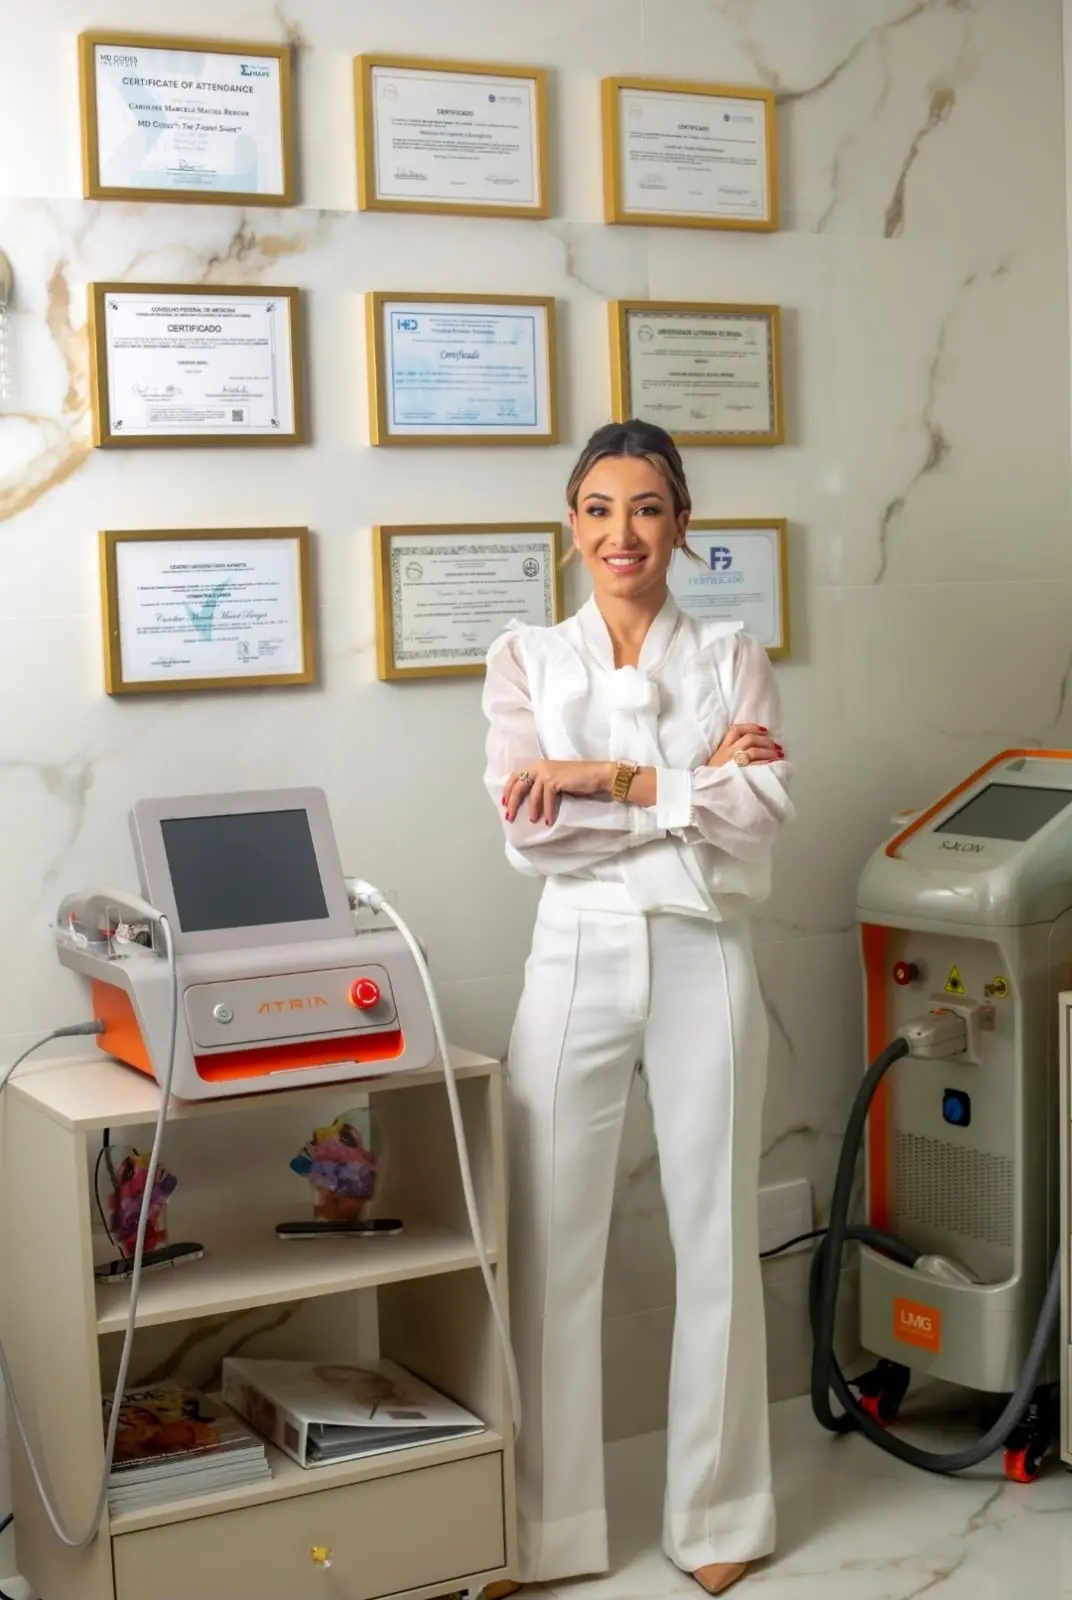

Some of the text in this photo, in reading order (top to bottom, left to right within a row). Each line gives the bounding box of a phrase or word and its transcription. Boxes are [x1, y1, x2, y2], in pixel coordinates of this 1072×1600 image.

[122, 76, 254, 94] CERTIFICATE OF ATTENDANCE
[436, 108, 474, 117] CERTIFICADO
[167, 324, 222, 333] CERTIFICADO
[440, 349, 480, 362] Certificado
[257, 995, 329, 1015] ATRIA
[900, 1309, 932, 1332] LMG
